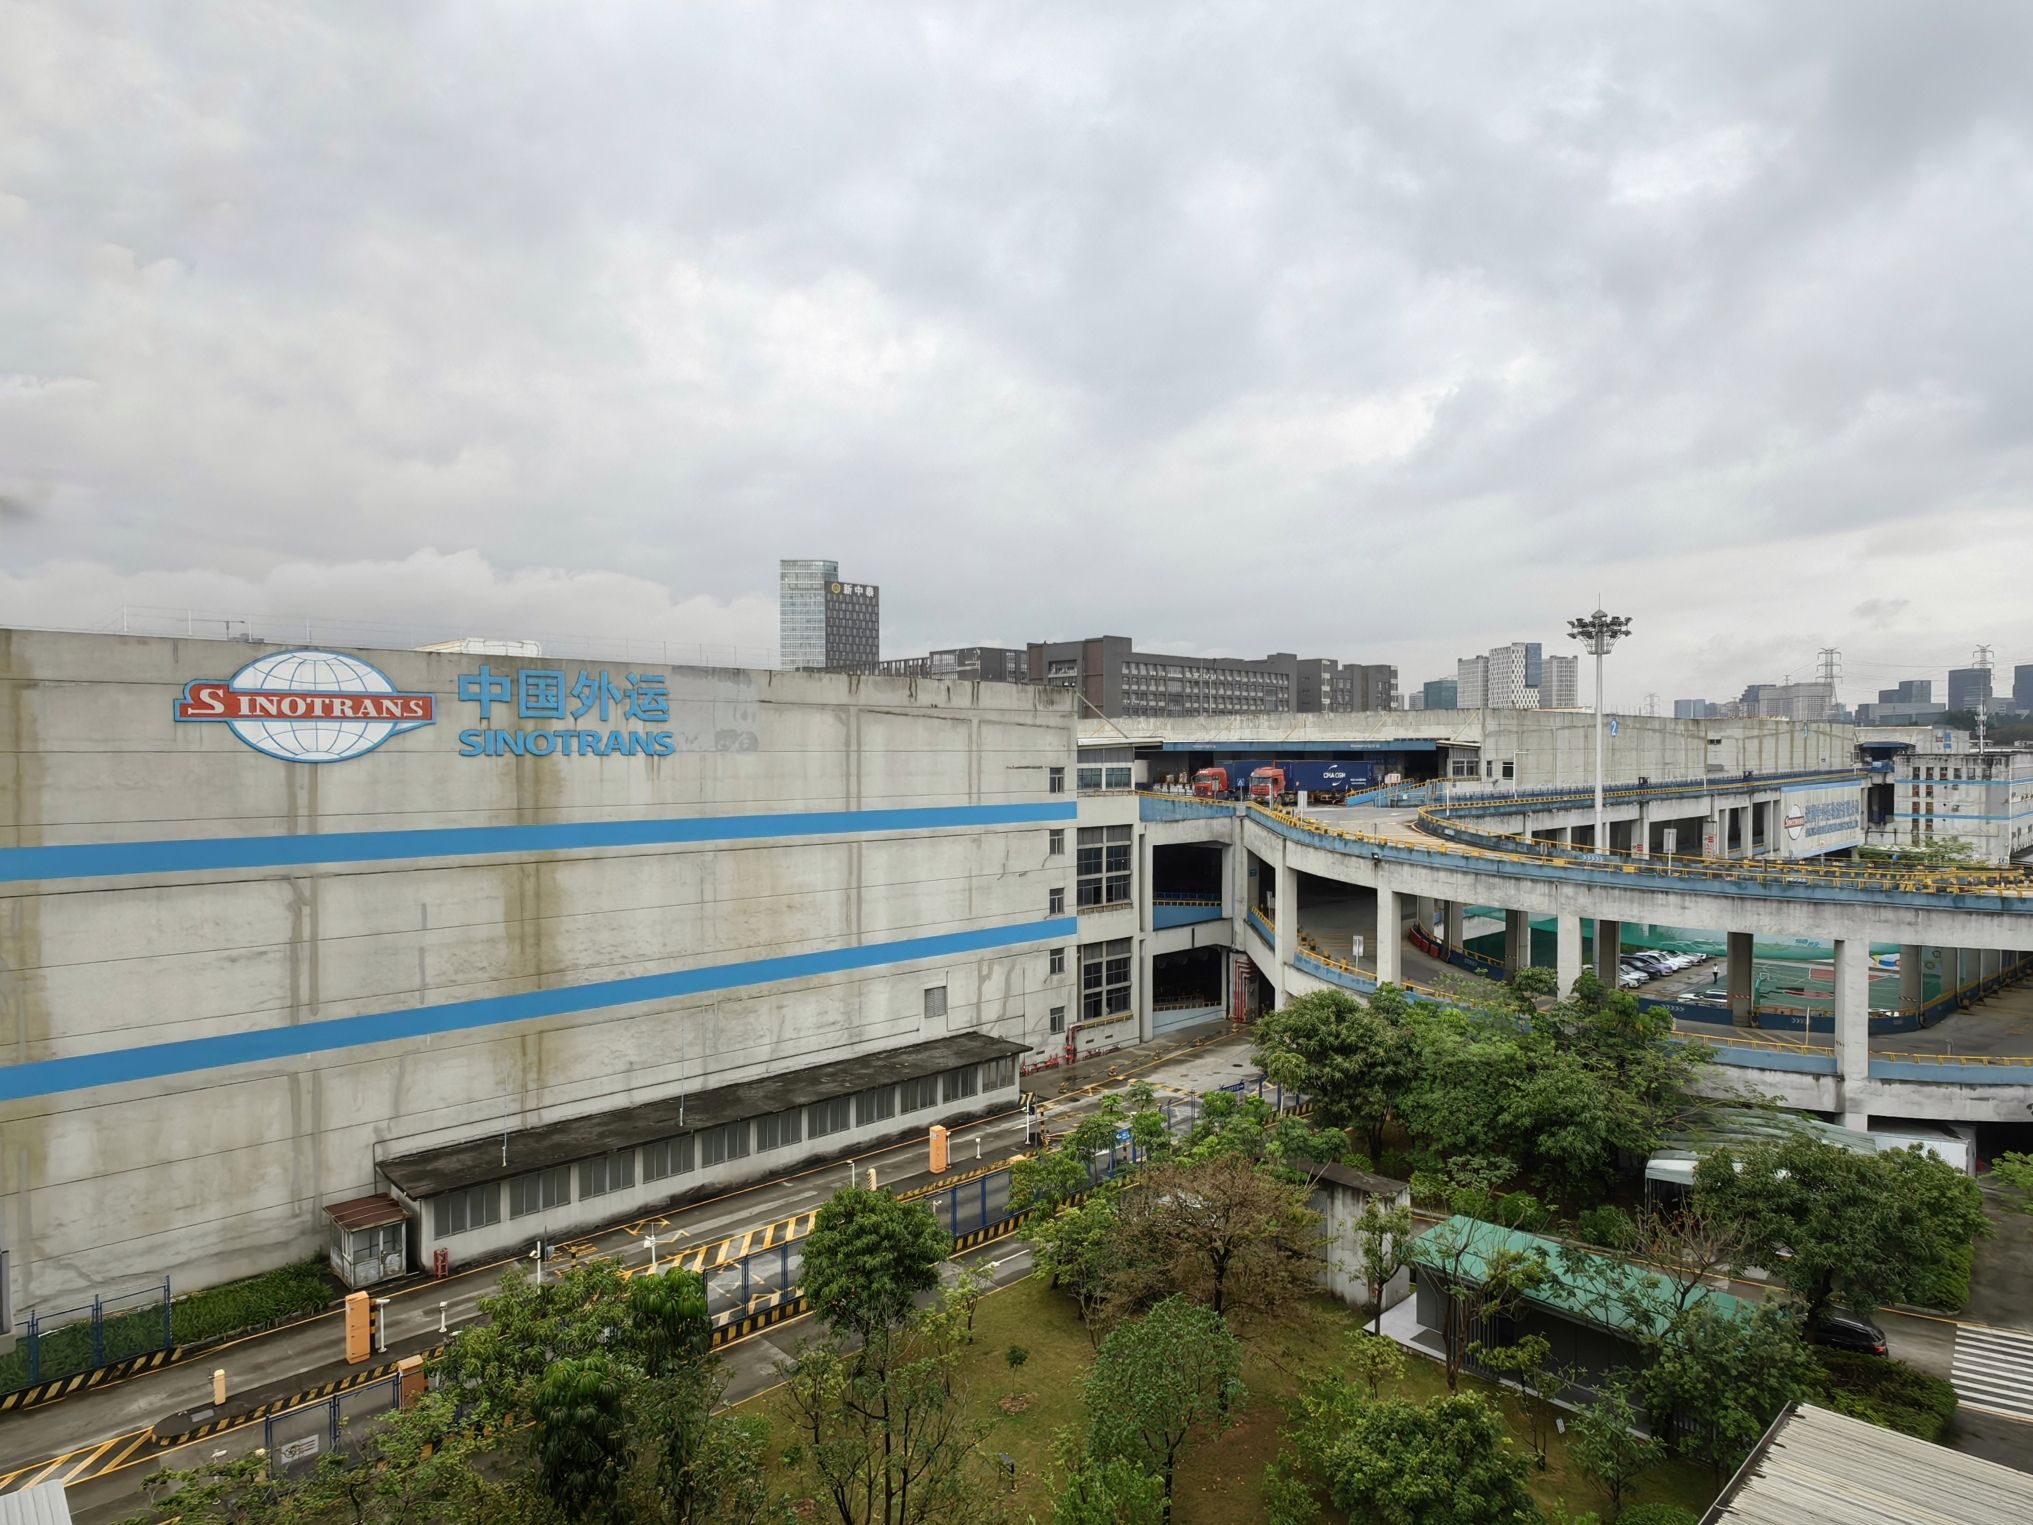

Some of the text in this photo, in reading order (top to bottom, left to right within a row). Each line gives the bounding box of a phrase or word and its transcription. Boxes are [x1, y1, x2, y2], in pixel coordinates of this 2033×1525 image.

[187, 688, 424, 718] SINOTRANS
[458, 664, 670, 722] 中国外运
[459, 728, 676, 757] SINOTRANS
[1611, 720, 1617, 736] 2
